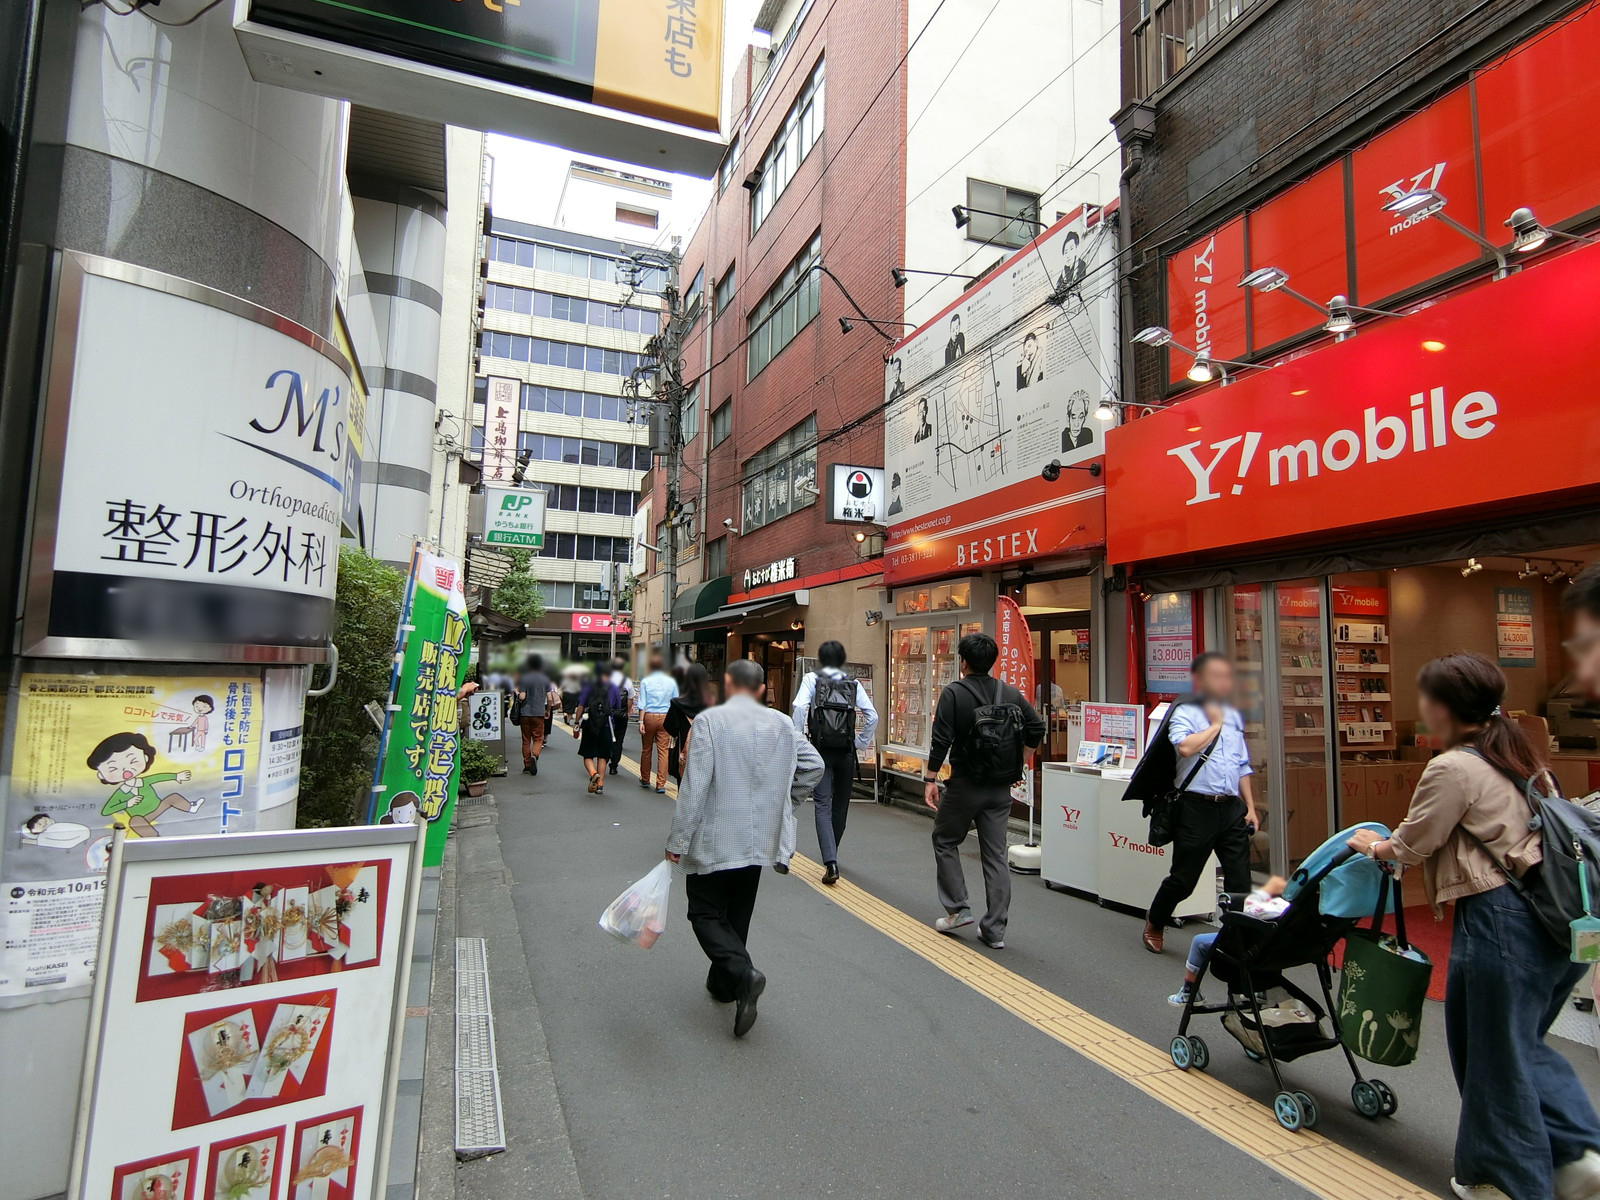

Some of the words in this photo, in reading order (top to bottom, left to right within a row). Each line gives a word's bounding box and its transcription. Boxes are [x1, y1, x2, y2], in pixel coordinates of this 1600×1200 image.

[249, 370, 344, 462] M's
[229, 479, 336, 525] Orthopaedics
[498, 511, 529, 519] BANK
[501, 495, 532, 511] JP
[100, 499, 327, 588] 整形外科
[493, 532, 536, 544] 銀行ATM
[494, 520, 534, 530] ゆうちょ銀行
[957, 528, 1039, 567] BESTEX
[222, 682, 239, 746] 骨折後にも
[238, 682, 252, 745] 転倒予防に
[404, 639, 439, 779] 販売店です。
[220, 749, 245, 834] ロコト
[1061, 805, 1081, 823] Y!
[1062, 823, 1078, 831] mobile
